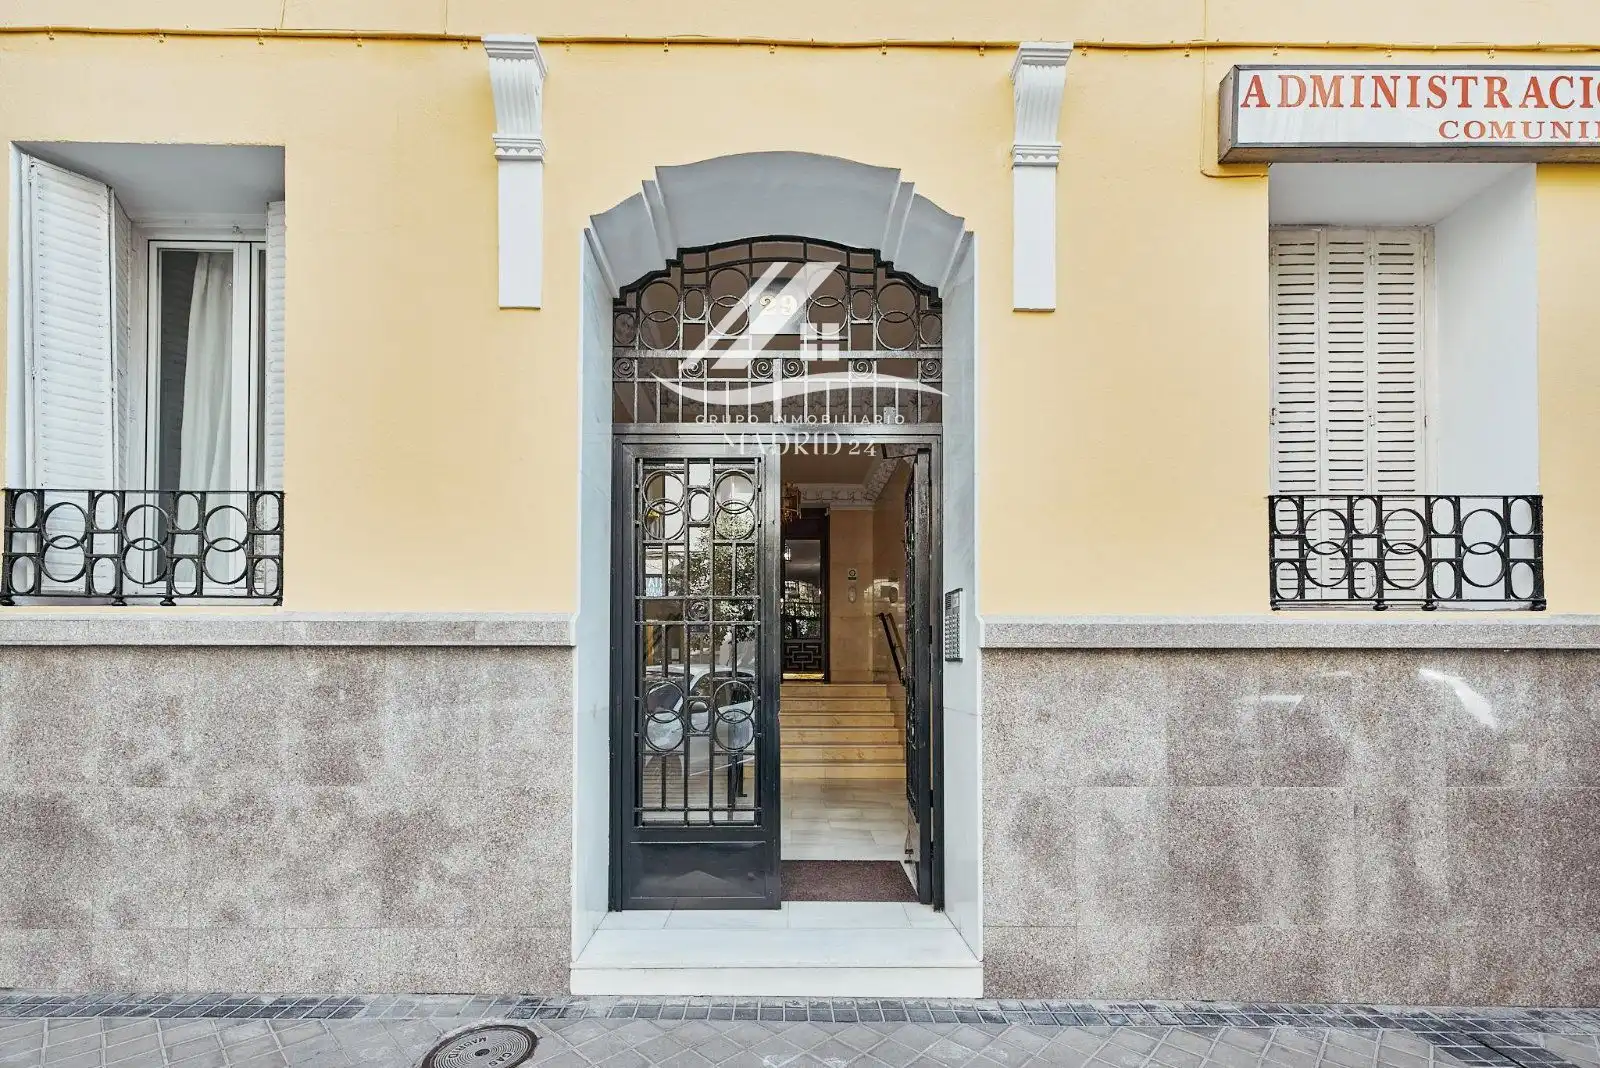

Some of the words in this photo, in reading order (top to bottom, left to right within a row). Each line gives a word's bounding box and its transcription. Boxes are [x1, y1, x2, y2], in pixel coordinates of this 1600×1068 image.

[1240, 74, 1600, 109] ADMINISTRACI
[1438, 120, 1600, 140] COMUNI
[759, 294, 798, 316] 29
[448, 1036, 487, 1059] MADRID
